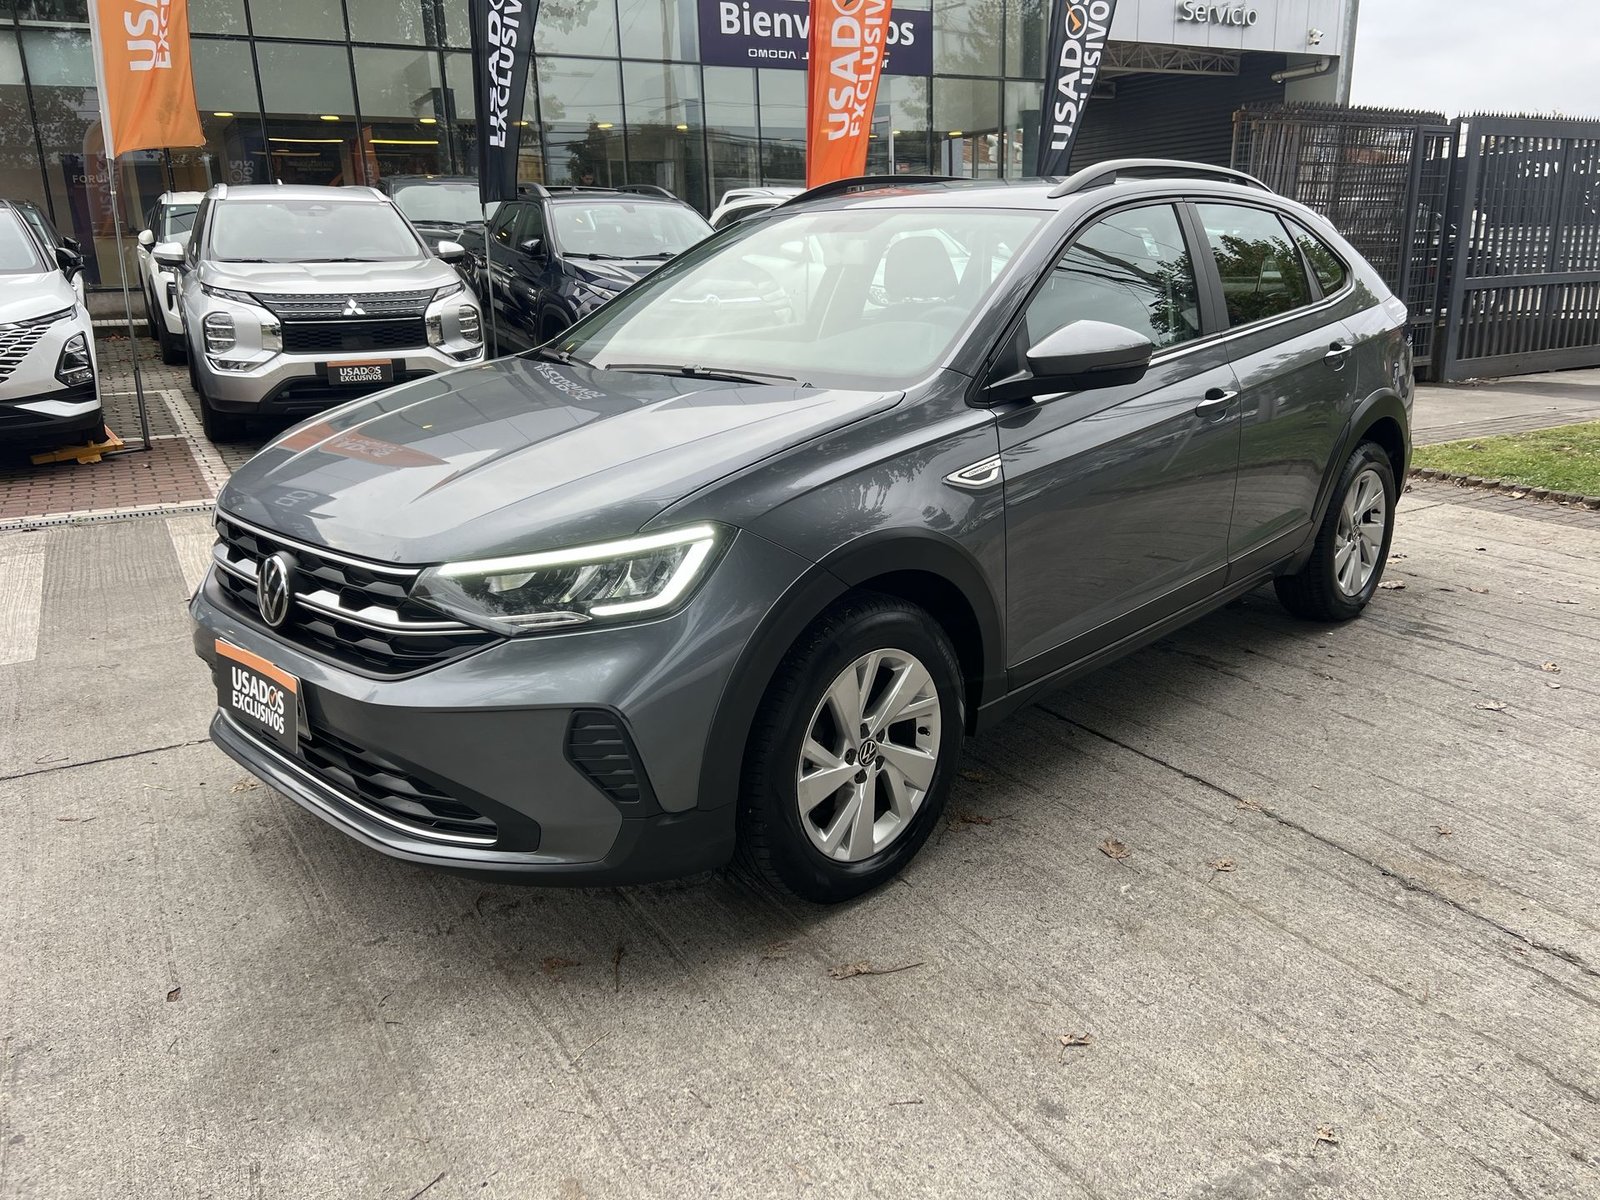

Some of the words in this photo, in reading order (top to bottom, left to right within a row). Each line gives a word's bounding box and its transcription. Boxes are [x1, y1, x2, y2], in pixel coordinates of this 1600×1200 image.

[124, 0, 159, 71] US
[719, 1, 915, 46] Bienvos
[1182, 0, 1258, 26] Servicio
[488, 0, 505, 147] USAD
[748, 48, 797, 60] OMODA
[1051, 0, 1088, 150] USADO
[340, 366, 381, 376] USADOS
[340, 374, 382, 382] EXCLUSIVOS
[232, 667, 285, 715] USADOS
[232, 690, 285, 735] EXCLUSIVOS
